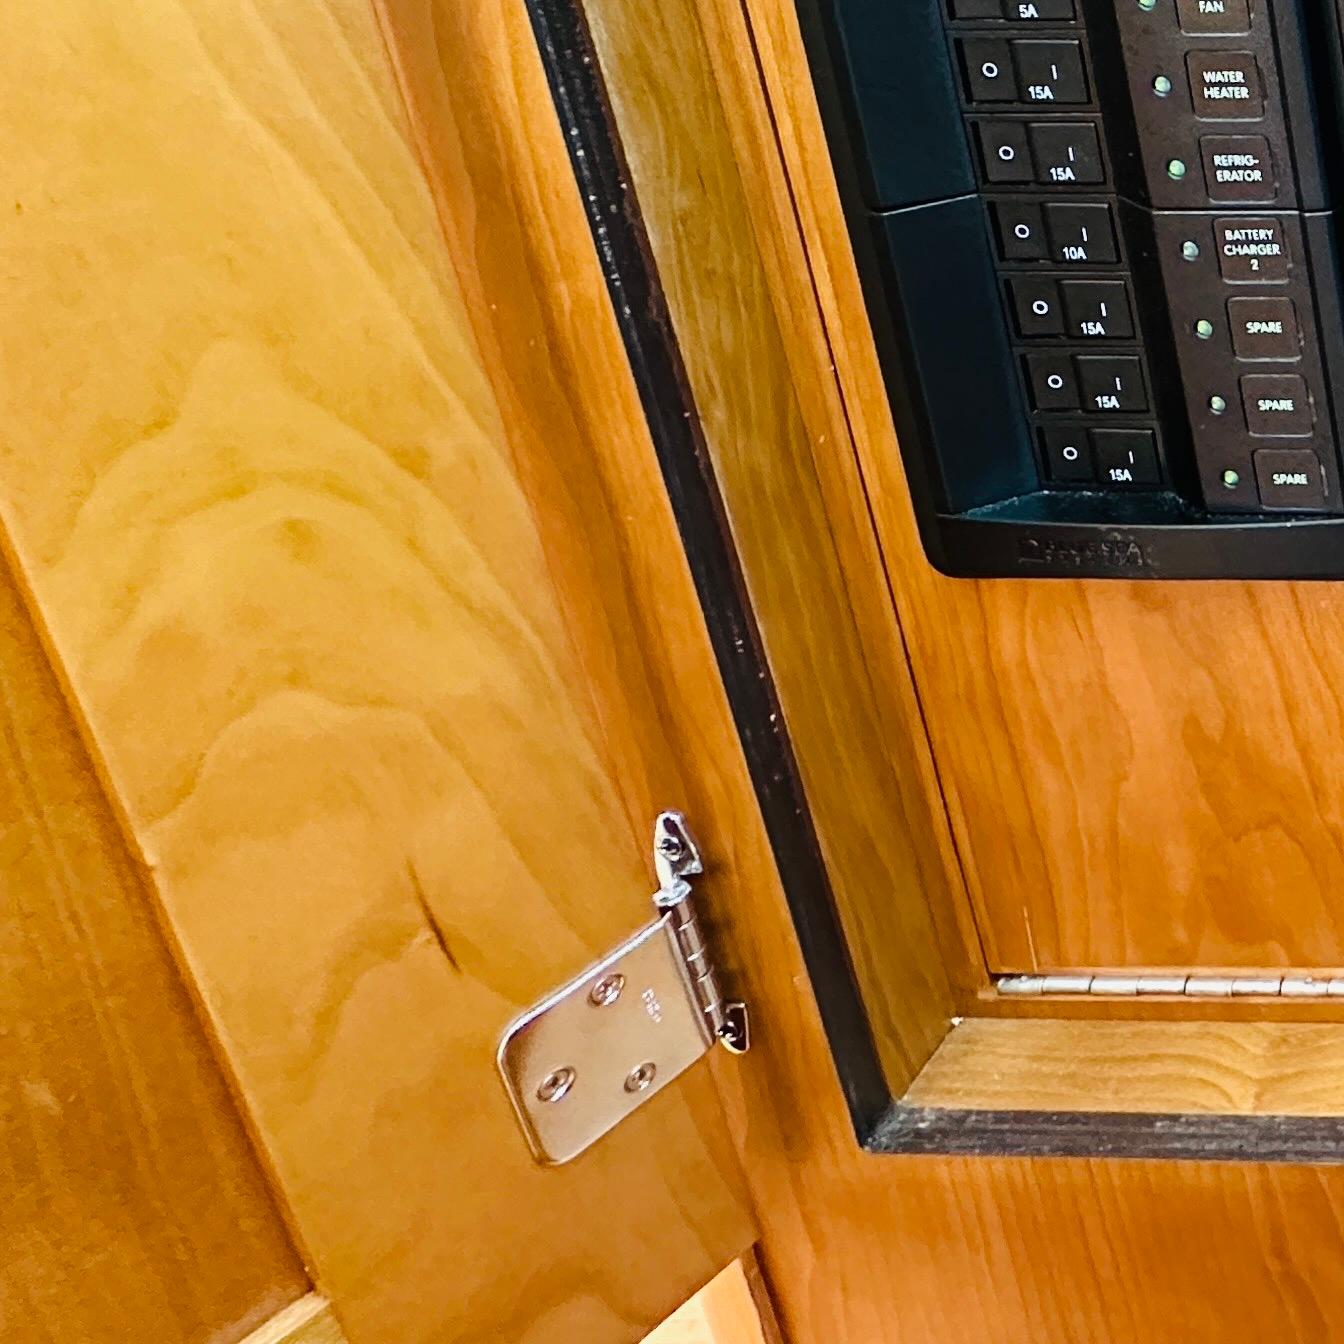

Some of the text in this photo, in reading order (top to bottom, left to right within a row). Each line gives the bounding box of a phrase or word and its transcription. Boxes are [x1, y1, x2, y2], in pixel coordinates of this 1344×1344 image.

[1019, 5, 1039, 18] 5A
[1199, 1, 1224, 13] FAN
[1203, 71, 1244, 84] WATER
[1203, 86, 1249, 100] HEATER
[1225, 229, 1274, 241] BATTERY
[1224, 243, 1281, 256] CHARGER
[1250, 258, 1259, 271] 2
[1246, 321, 1282, 335] SPARE
